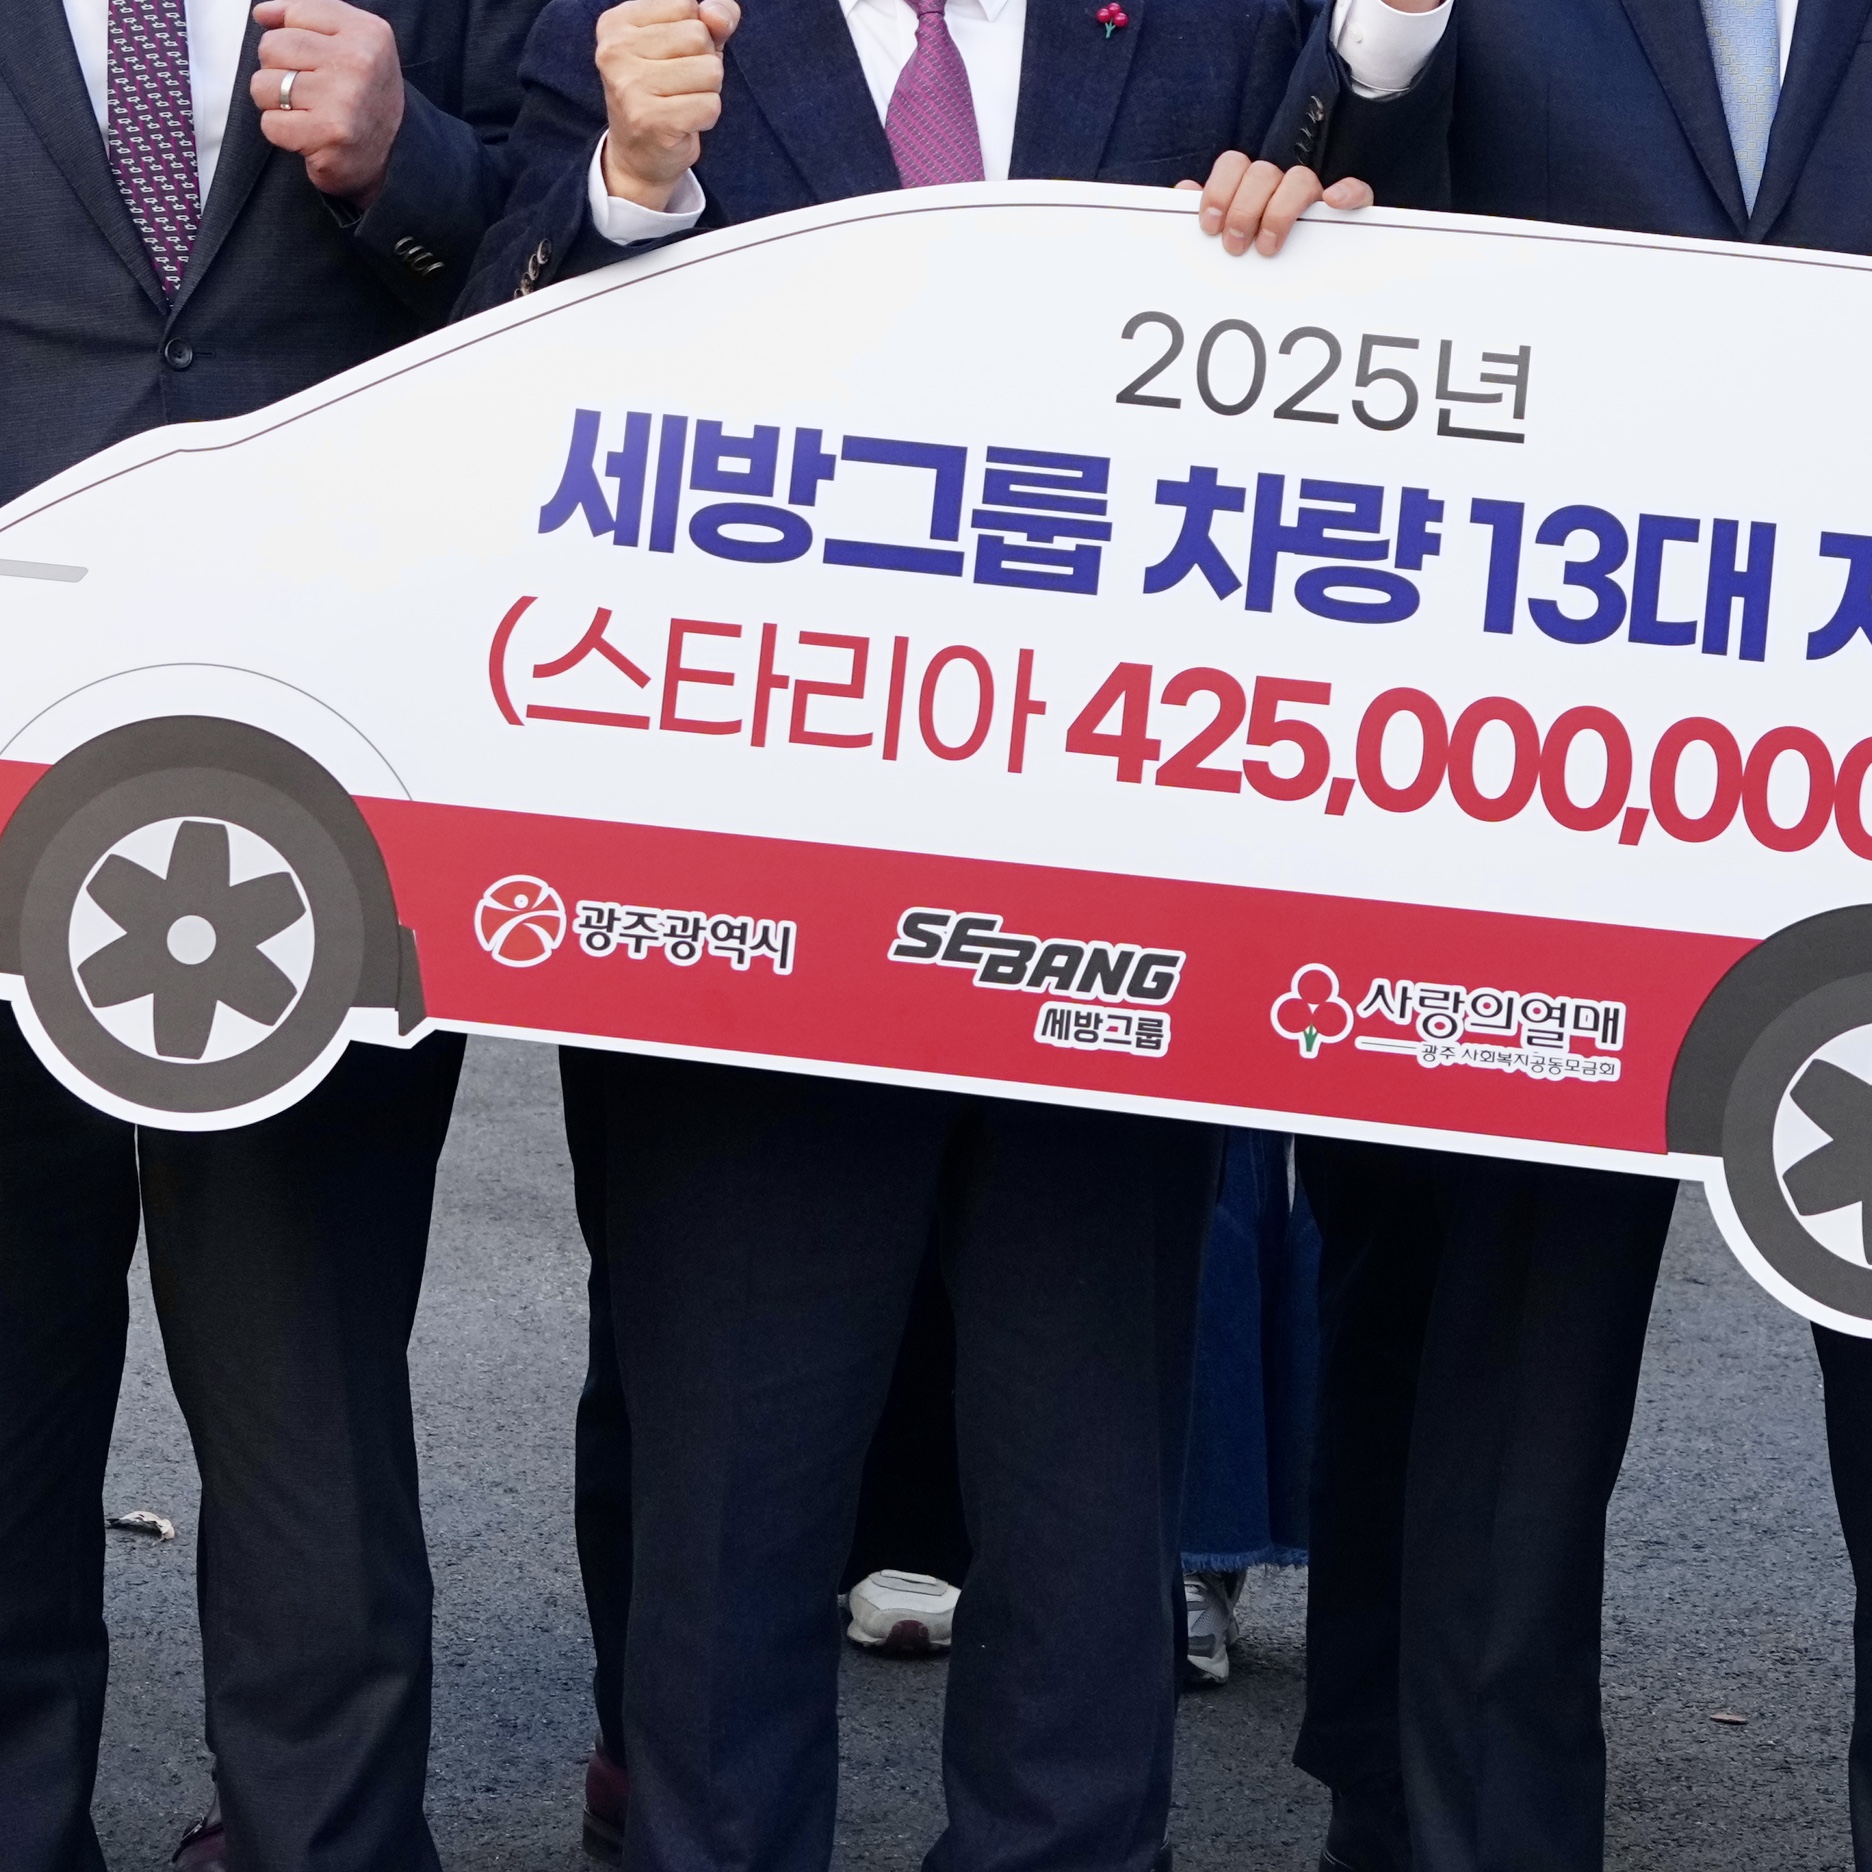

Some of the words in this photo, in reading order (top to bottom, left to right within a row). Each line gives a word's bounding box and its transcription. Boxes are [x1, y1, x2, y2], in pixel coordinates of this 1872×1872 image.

[1114, 310, 1532, 445] 2025년
[540, 412, 1113, 594] 세방그룹
[1143, 467, 1445, 622] 차량
[1471, 498, 1776, 661] 13대
[488, 594, 1048, 775] (스타리아
[577, 906, 791, 970] 광주광역시
[893, 911, 1181, 1001] SEBANG
[1040, 1008, 1165, 1051] 세방그룹
[1361, 983, 1621, 1049] 사랑의열매
[1421, 1043, 1456, 1063] 광주
[1462, 1047, 1615, 1076] 사회복지공동모금회
